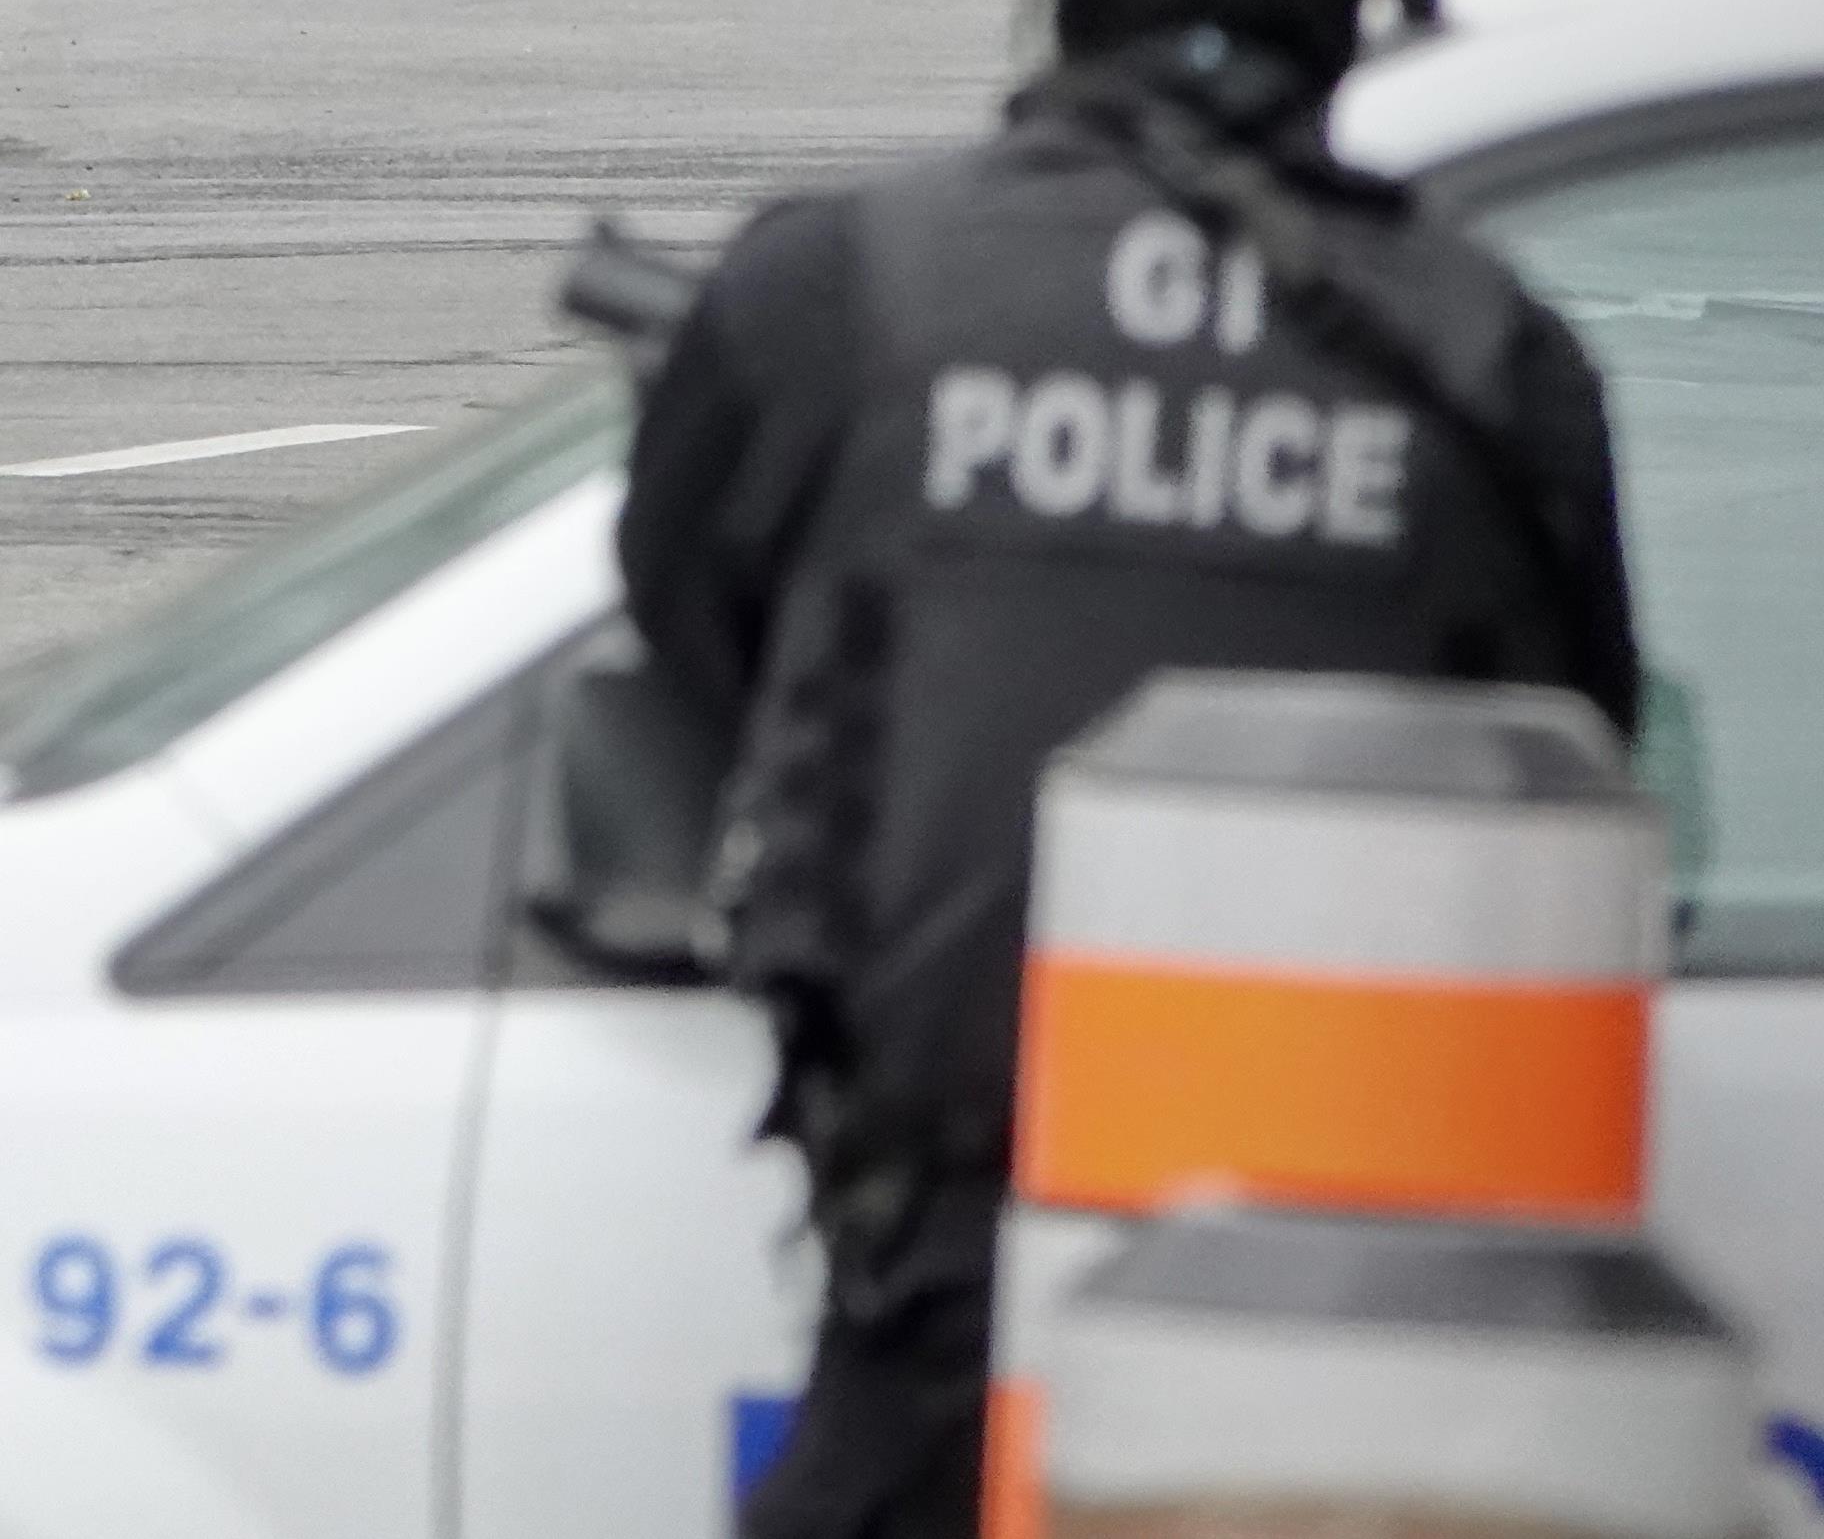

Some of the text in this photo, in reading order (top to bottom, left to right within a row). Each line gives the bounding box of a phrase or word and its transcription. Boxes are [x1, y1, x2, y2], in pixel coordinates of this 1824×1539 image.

[1104, 209, 1266, 355] GI
[923, 363, 1413, 549] POLICE
[34, 1229, 404, 1379] 92-6
